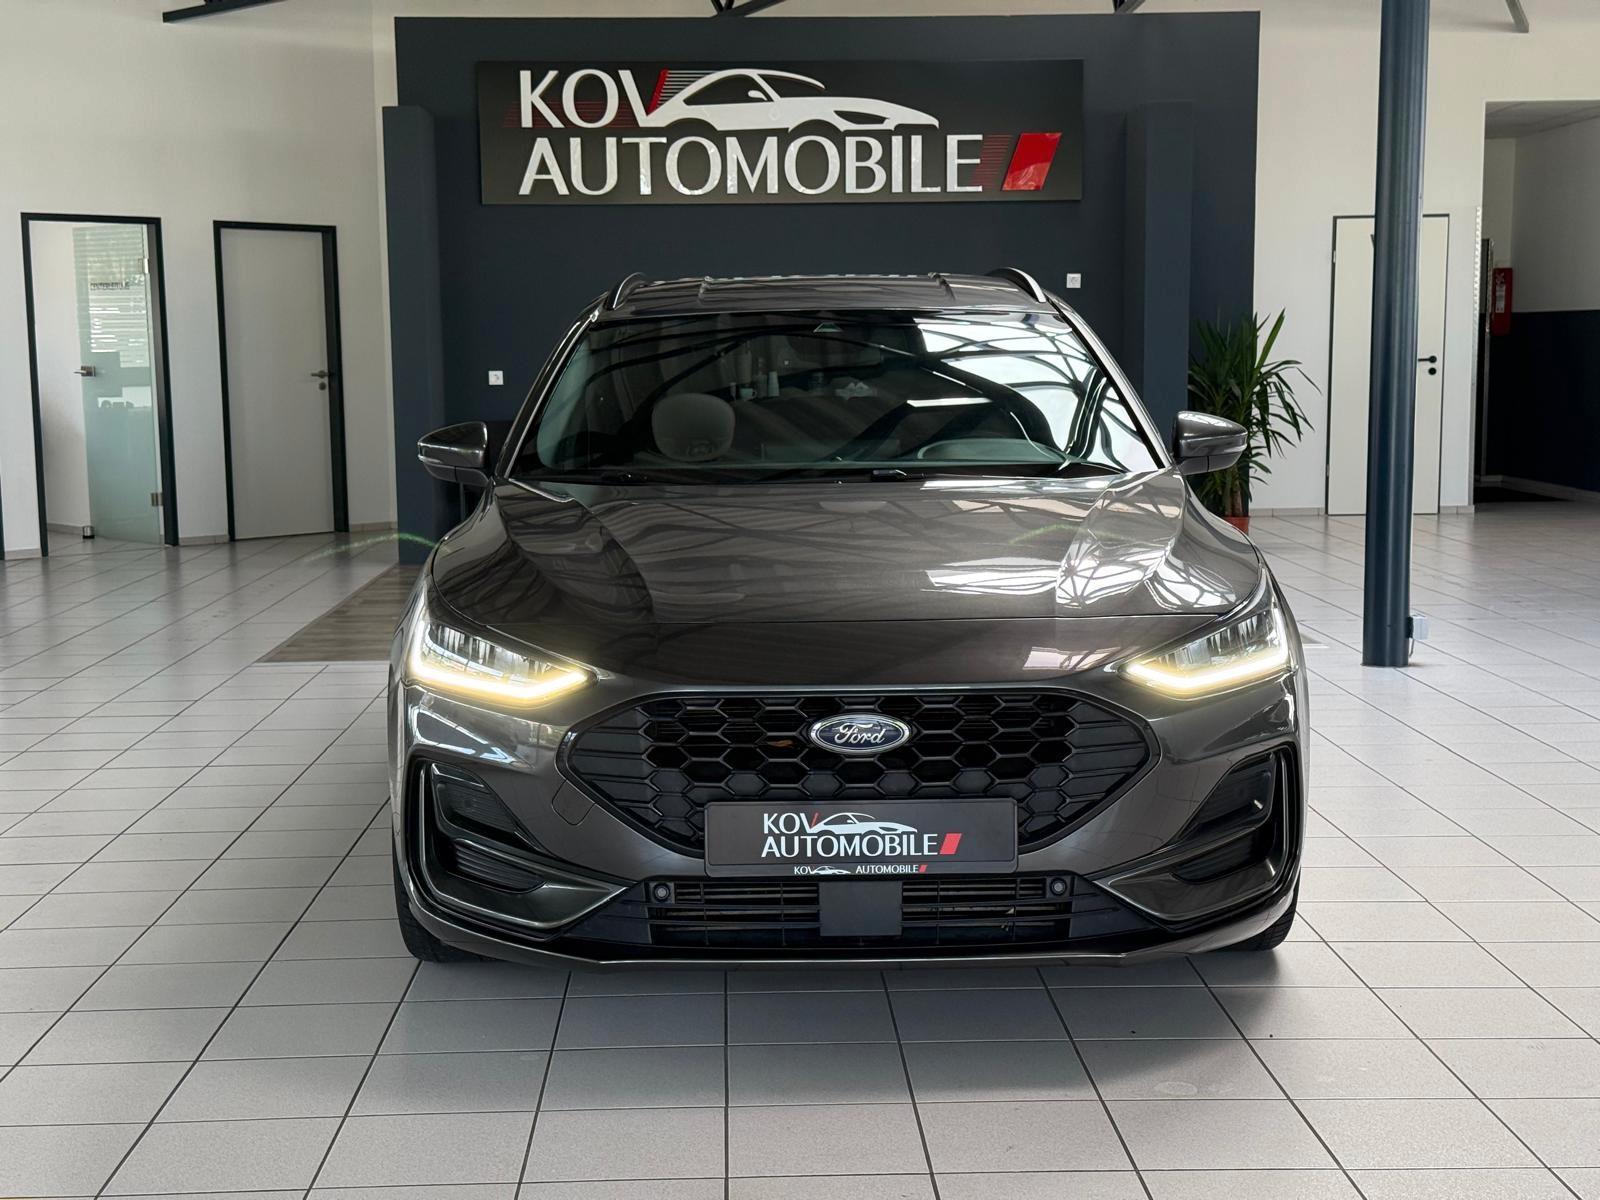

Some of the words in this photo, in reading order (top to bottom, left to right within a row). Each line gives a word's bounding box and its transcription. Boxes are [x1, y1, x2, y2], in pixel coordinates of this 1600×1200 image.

[519, 69, 668, 128] KOV
[518, 134, 983, 195] AUTOMOBILE
[834, 722, 886, 745] Ford
[763, 812, 820, 834] KOV
[761, 833, 938, 858] AUTOMOBILE
[855, 864, 919, 874] AUTOMOBILE
